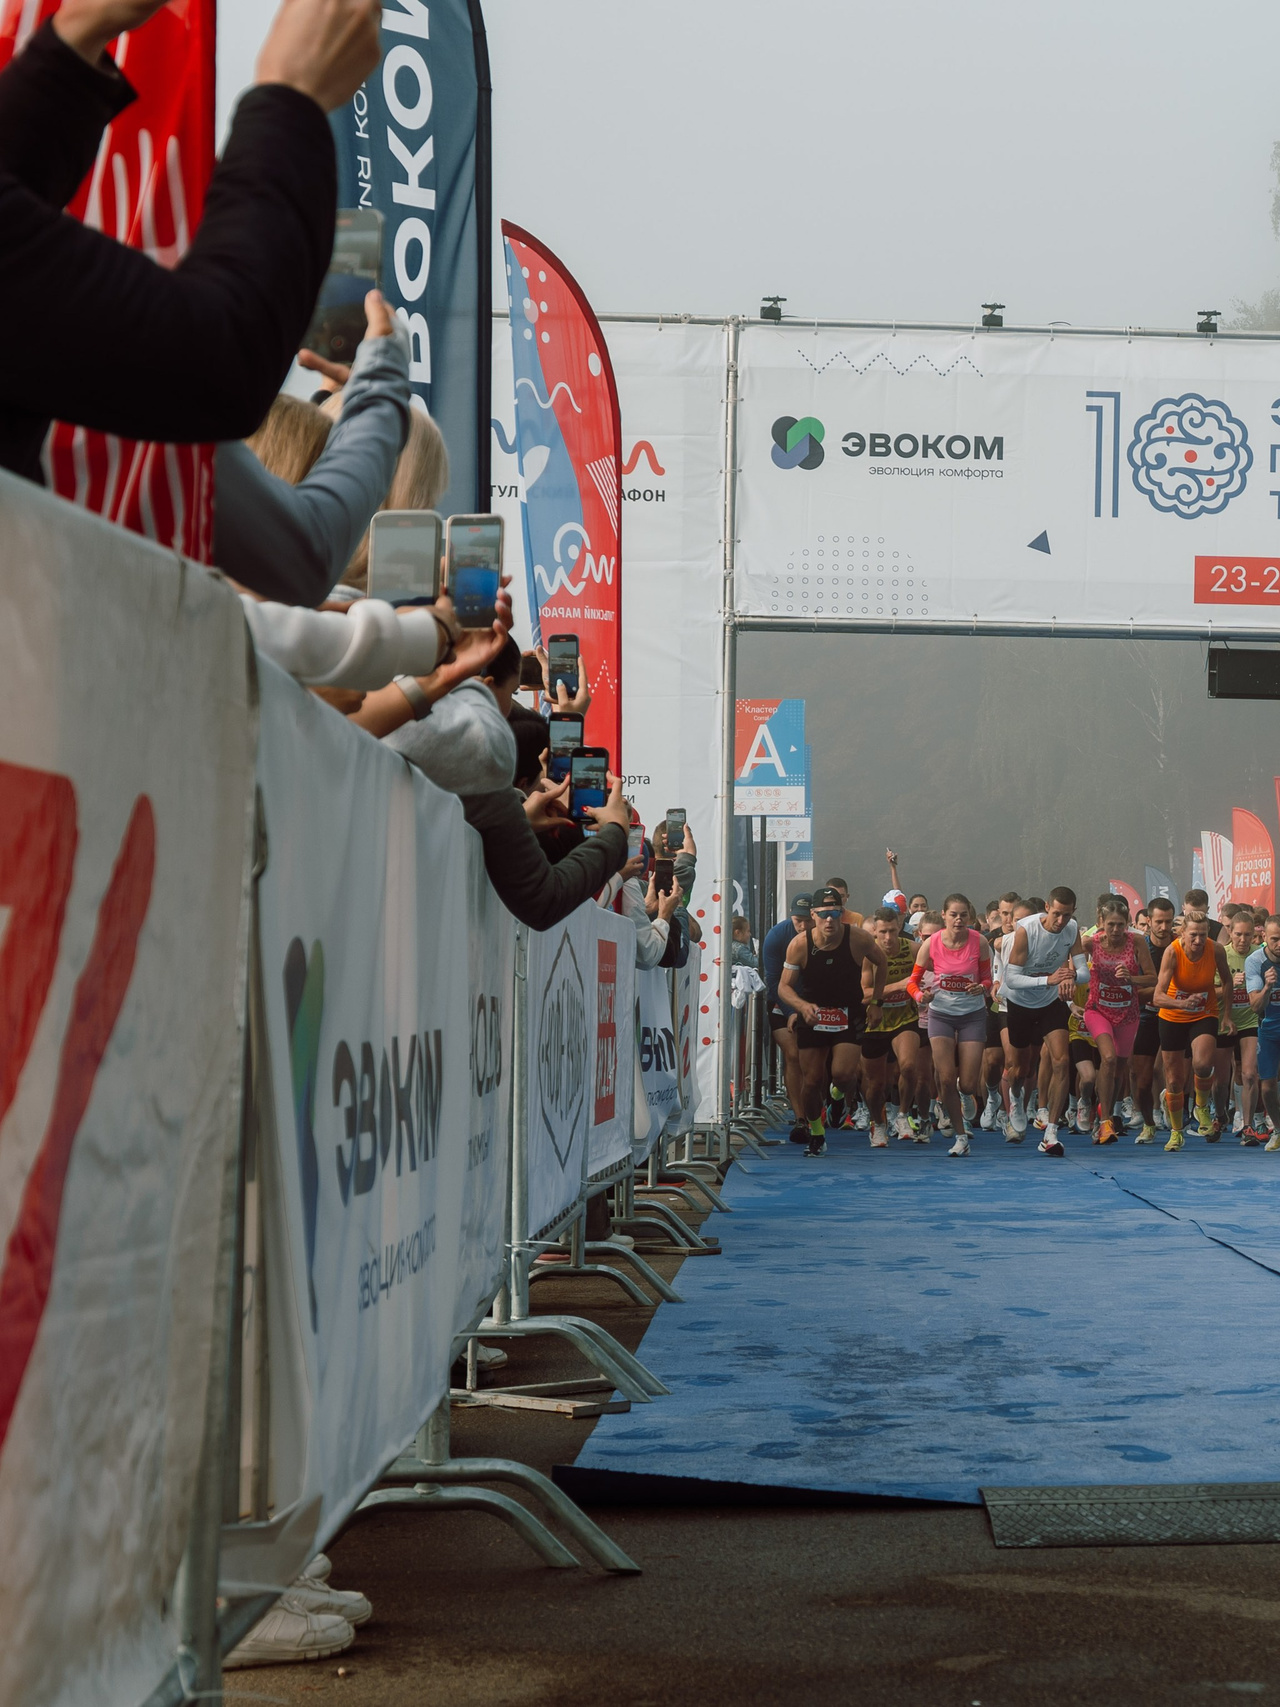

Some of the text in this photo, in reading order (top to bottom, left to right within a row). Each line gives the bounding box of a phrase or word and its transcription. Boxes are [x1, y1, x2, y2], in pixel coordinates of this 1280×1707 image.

[841, 431, 1004, 461] ЭВОКОМ
[869, 466, 1004, 480] эволюция комфорта
[745, 705, 778, 715] Кластер
